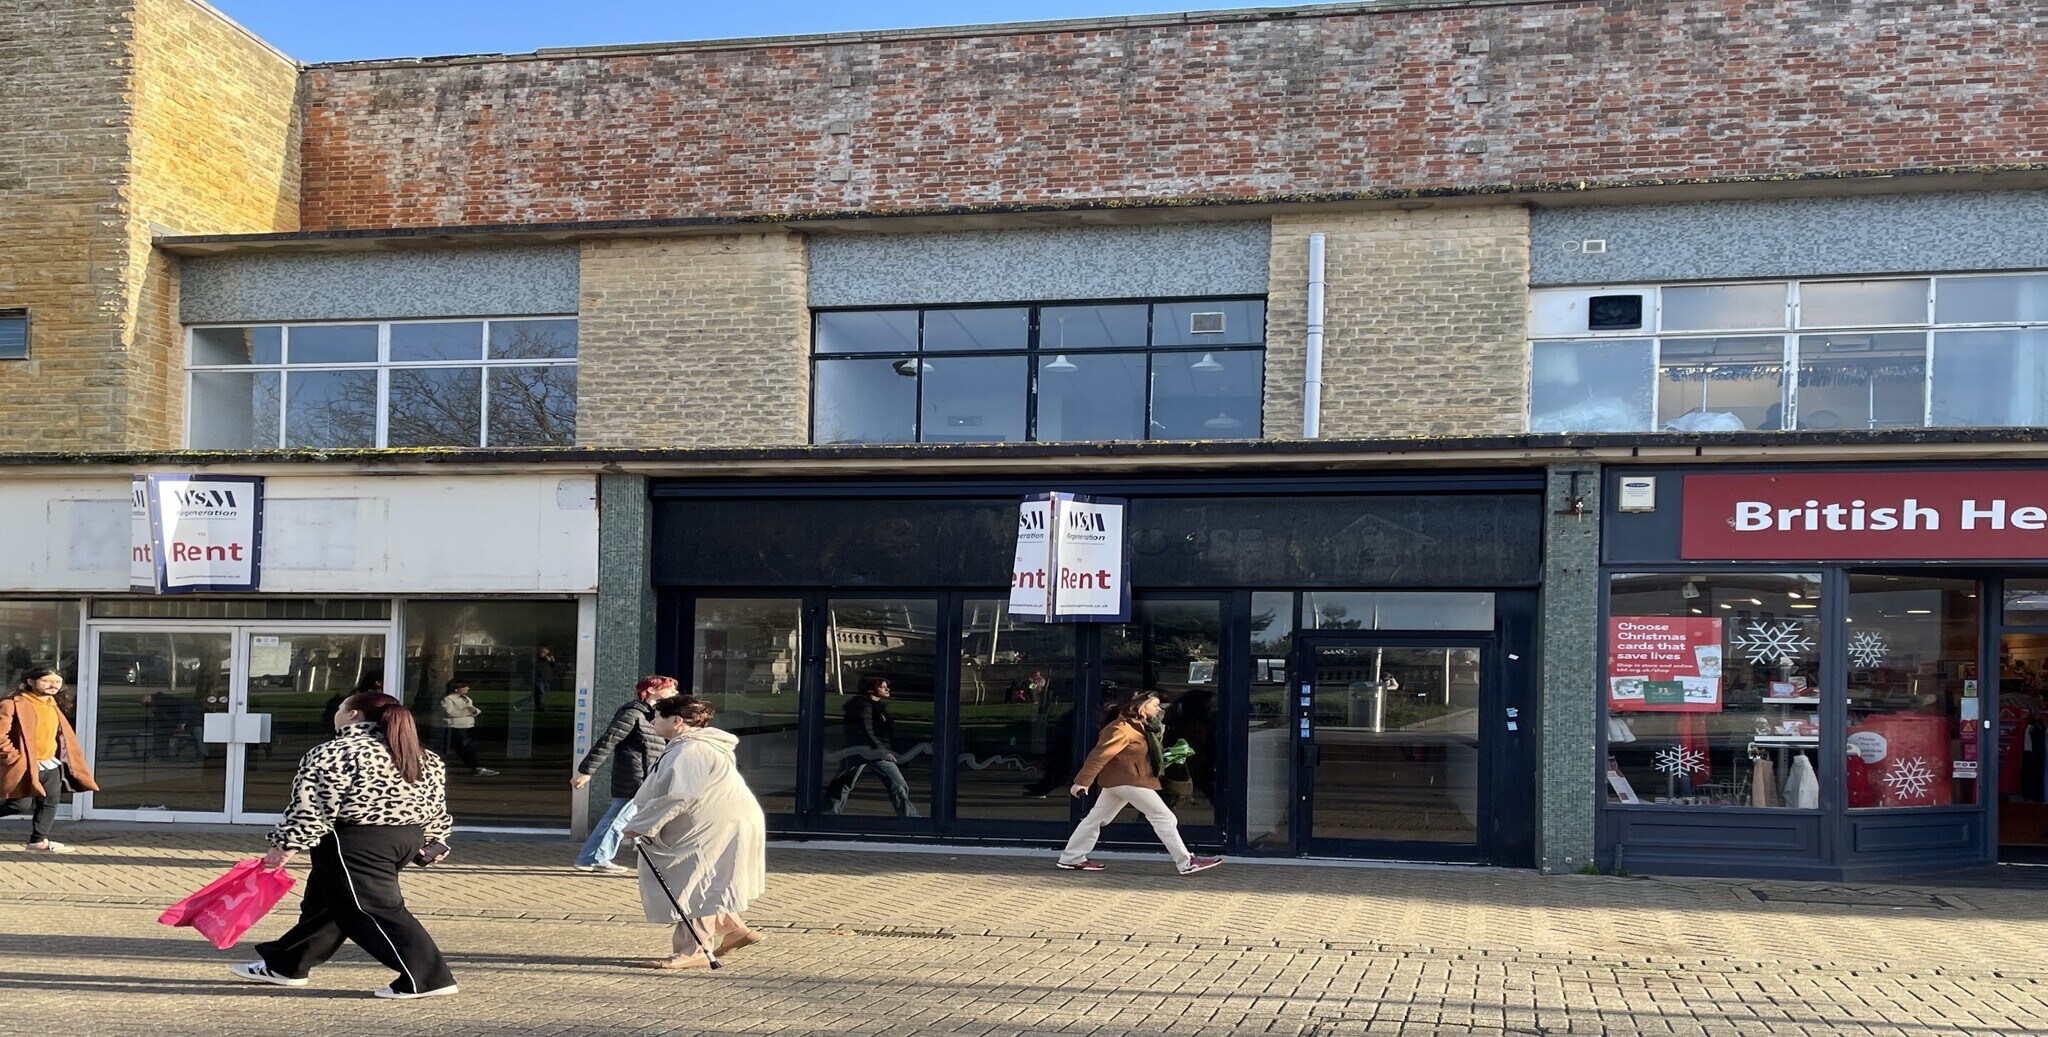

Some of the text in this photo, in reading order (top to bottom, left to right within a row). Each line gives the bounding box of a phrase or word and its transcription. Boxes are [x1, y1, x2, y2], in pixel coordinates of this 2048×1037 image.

[1019, 511, 1044, 529] SM
[1735, 498, 2048, 531] British He
[172, 542, 243, 562] Rent
[1061, 567, 1111, 590] Rent
[1618, 622, 1670, 631] Choose
[1617, 632, 1687, 640] Christmas
[1617, 642, 1687, 650] cards that
[1650, 652, 1682, 660] lives
